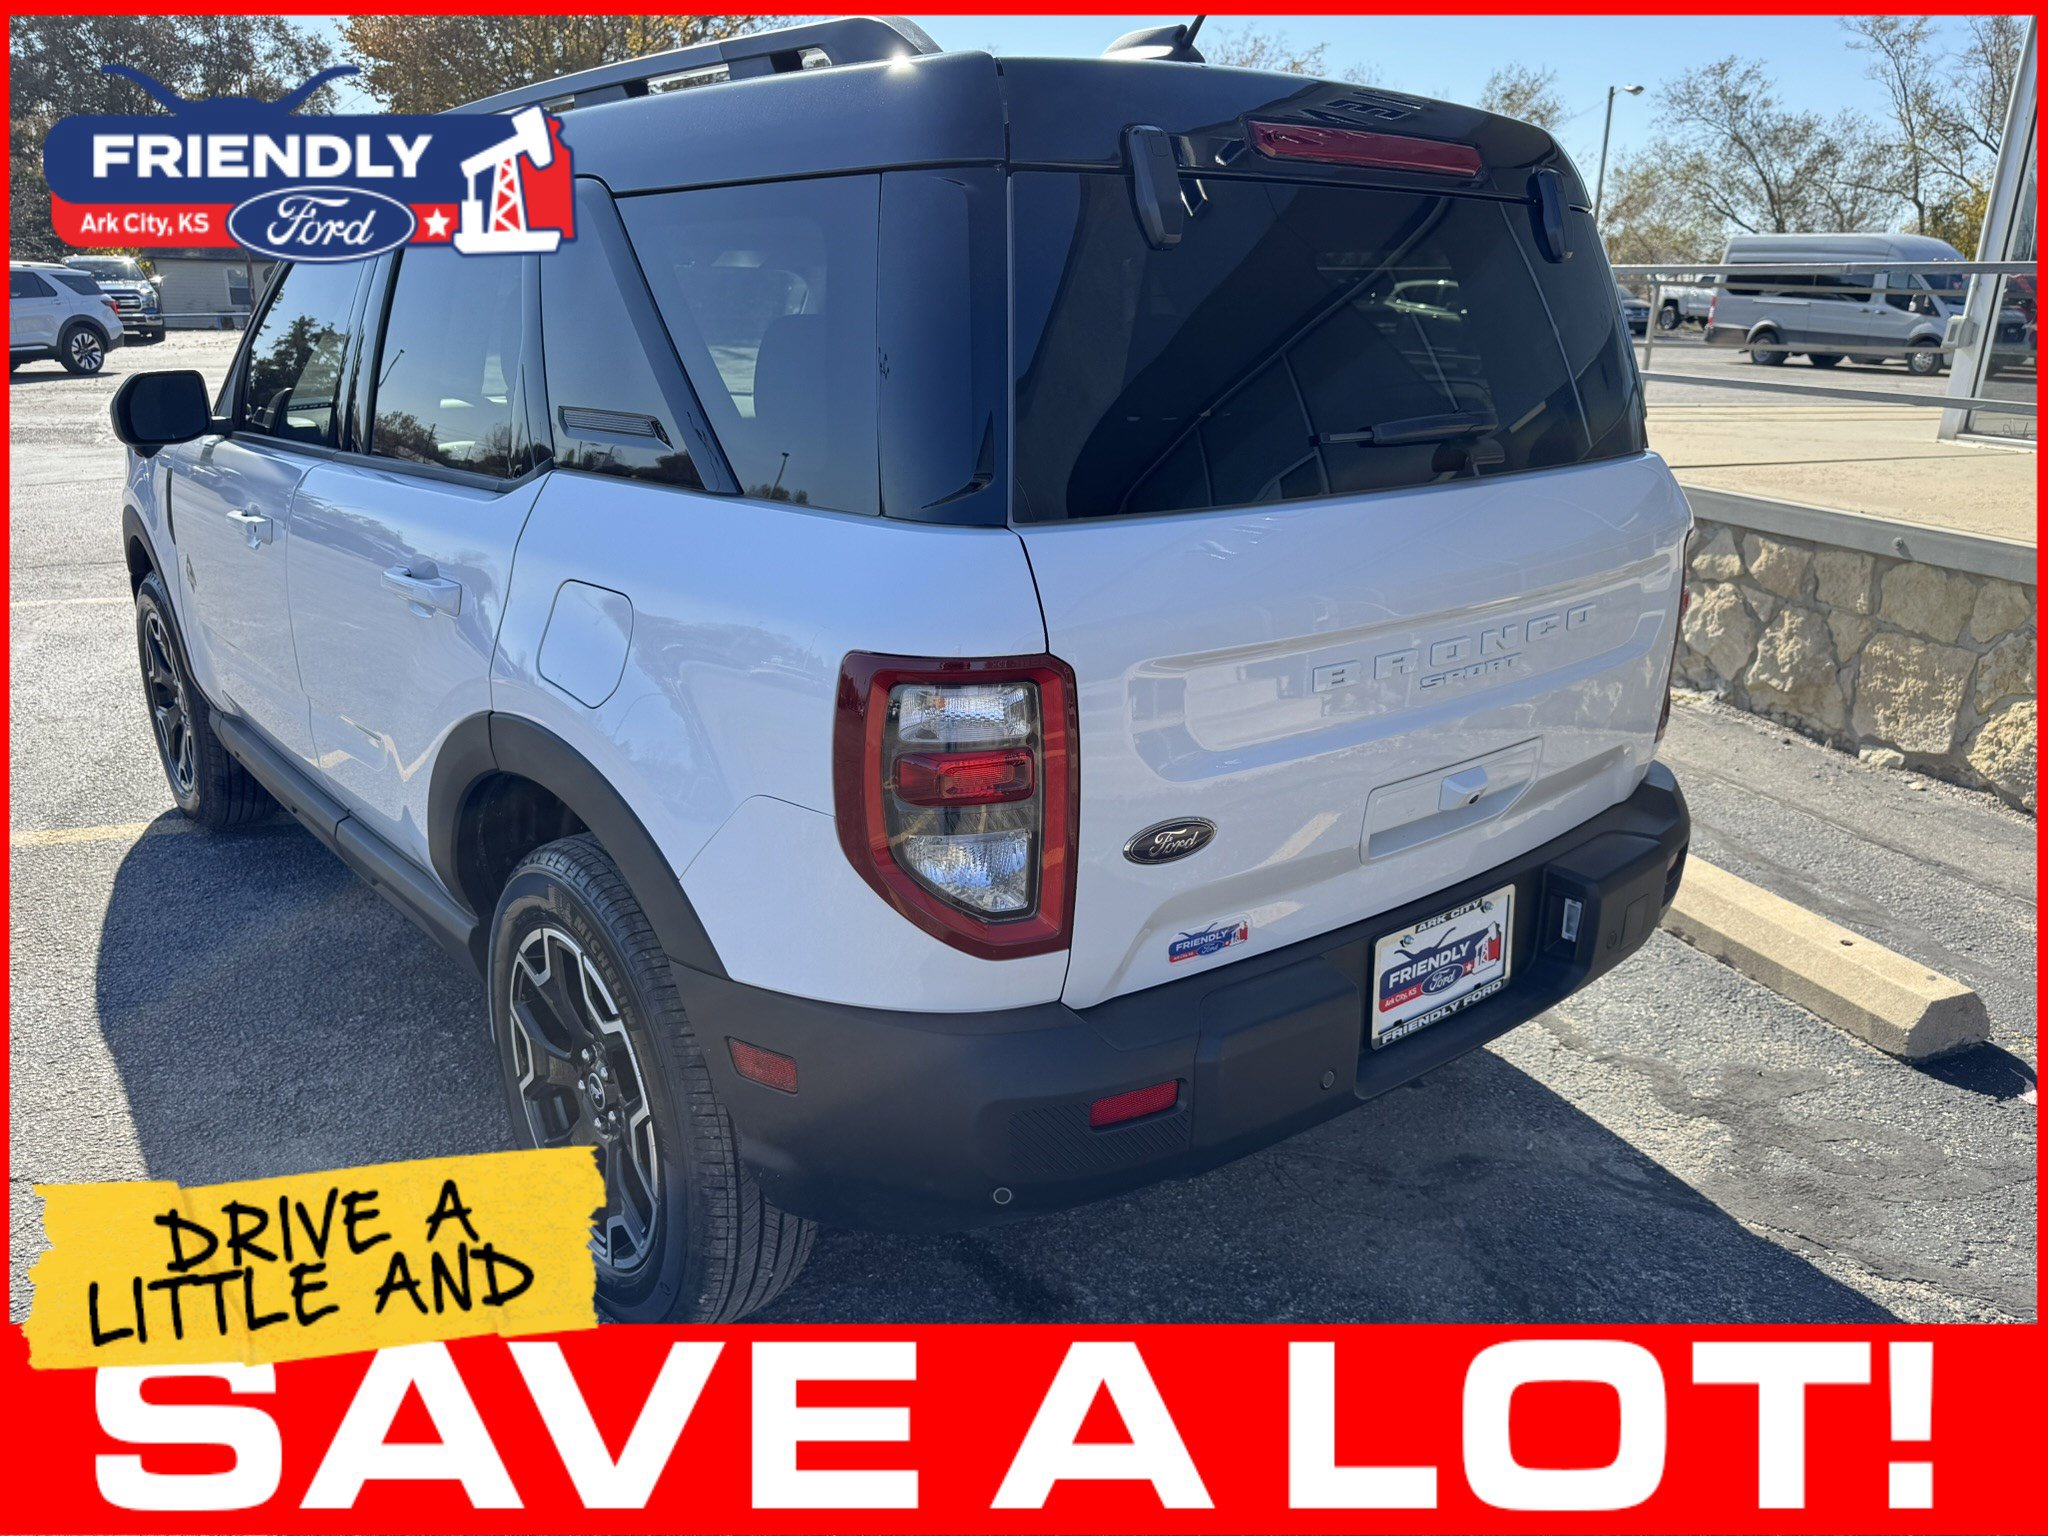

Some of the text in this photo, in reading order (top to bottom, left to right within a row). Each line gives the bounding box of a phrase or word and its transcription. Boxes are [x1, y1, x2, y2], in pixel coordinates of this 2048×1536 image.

[1312, 603, 1596, 693] BRONCO
[1420, 652, 1522, 690] SPORT
[1149, 828, 1199, 857] Ford
[1417, 899, 1483, 933] ARK CITY
[1176, 929, 1228, 951] FRIENDLY
[573, 916, 641, 1032] MICHELIN
[1389, 940, 1471, 989] FRIENDLY
[1429, 967, 1457, 991] Ford
[1382, 981, 1503, 1044] FRIENDLY FORD
